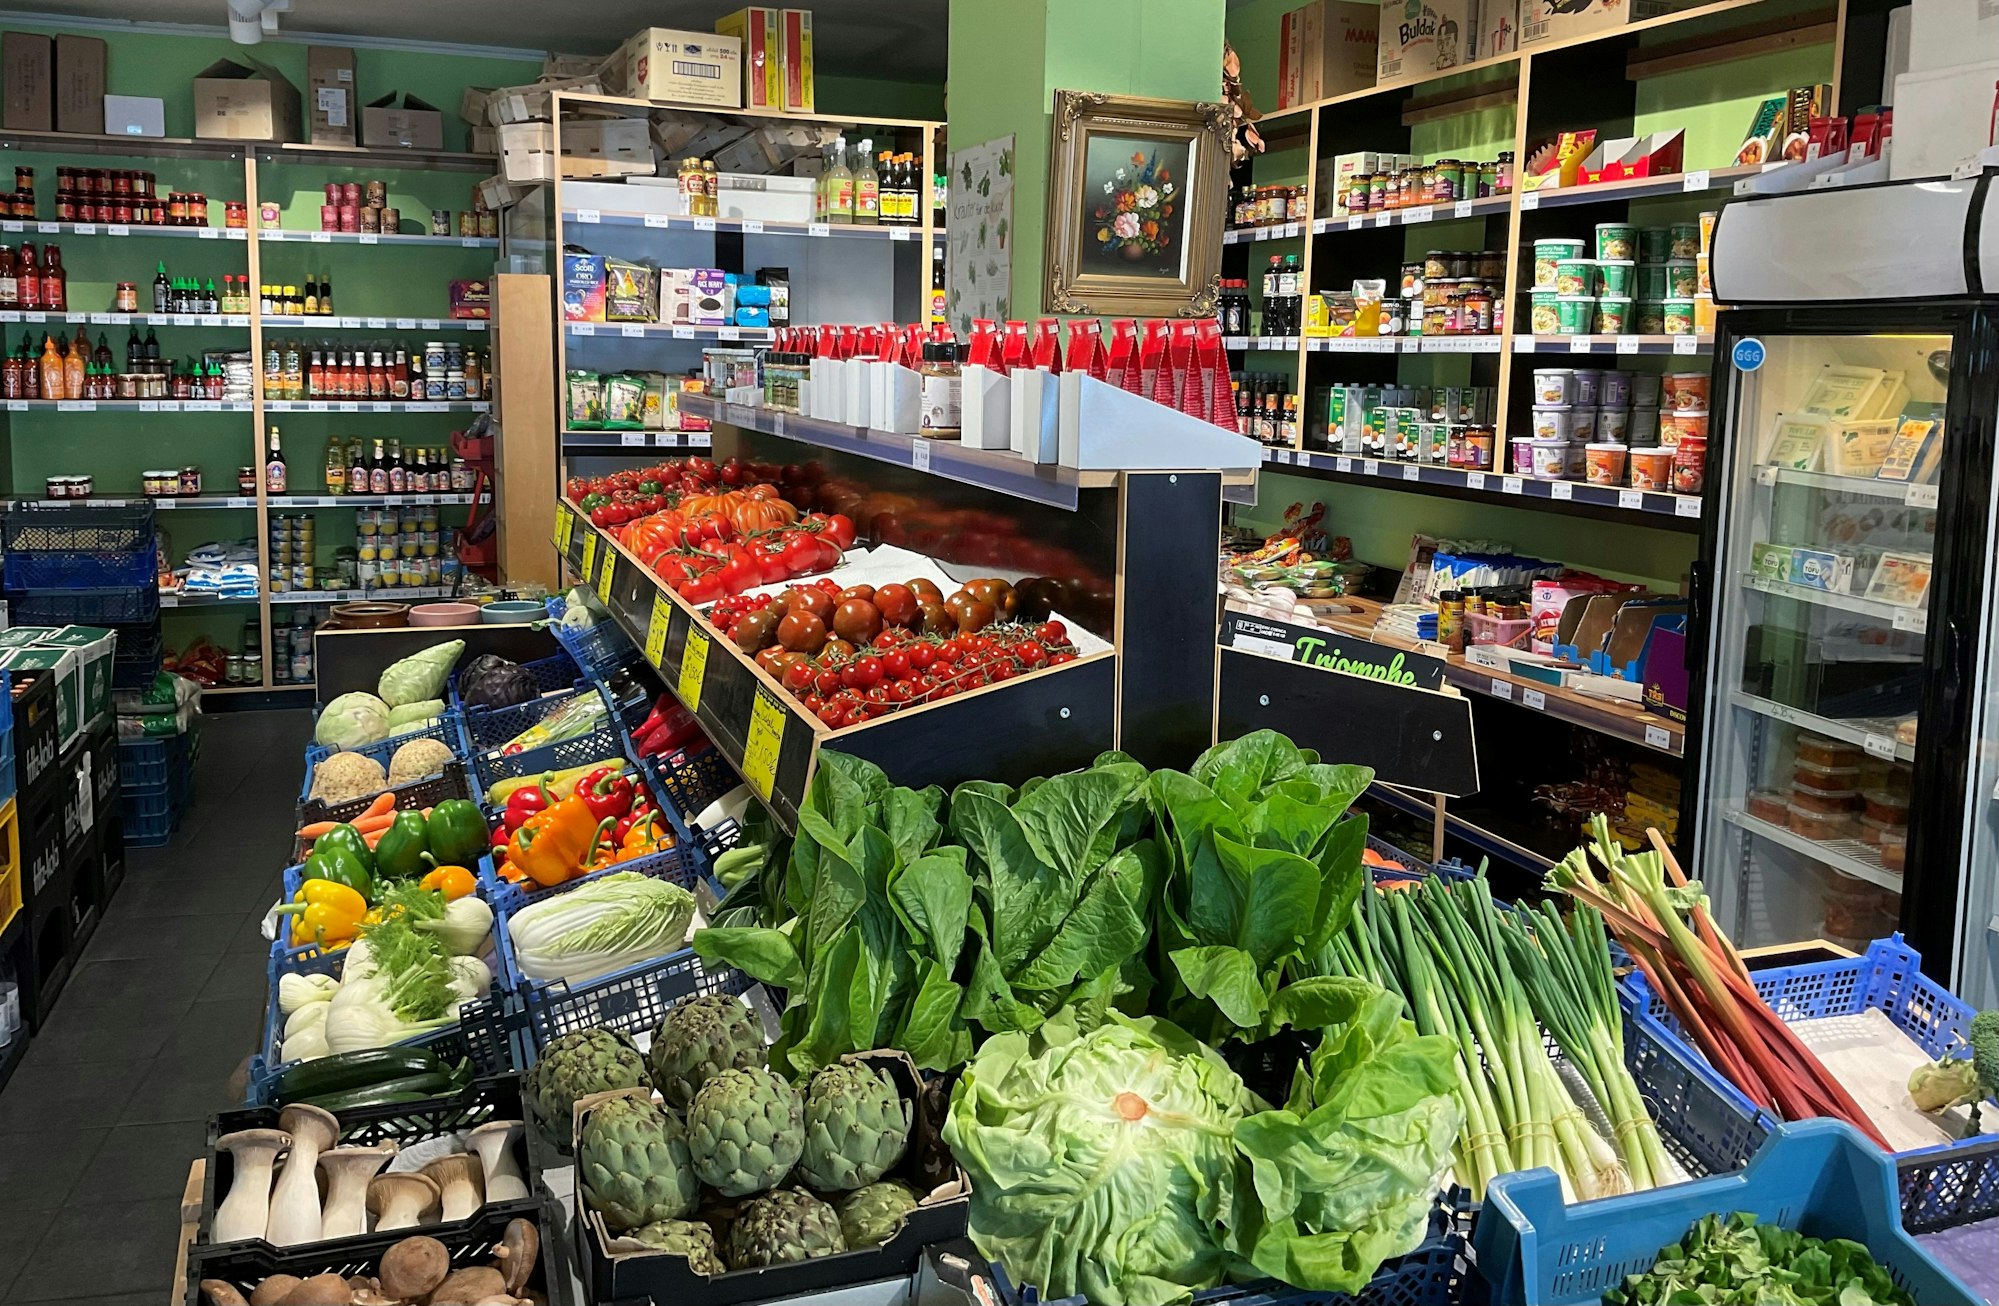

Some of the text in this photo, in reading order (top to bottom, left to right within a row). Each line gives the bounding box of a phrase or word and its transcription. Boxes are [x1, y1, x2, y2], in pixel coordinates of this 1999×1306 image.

[1399, 18, 1436, 46] Buldak
[698, 280, 723, 288] RICE BERRY
[1736, 350, 1760, 361] GGG
[1765, 559, 1778, 567] TOFU
[1805, 566, 1820, 574] TOFU
[1296, 636, 1417, 687] Triomphe
